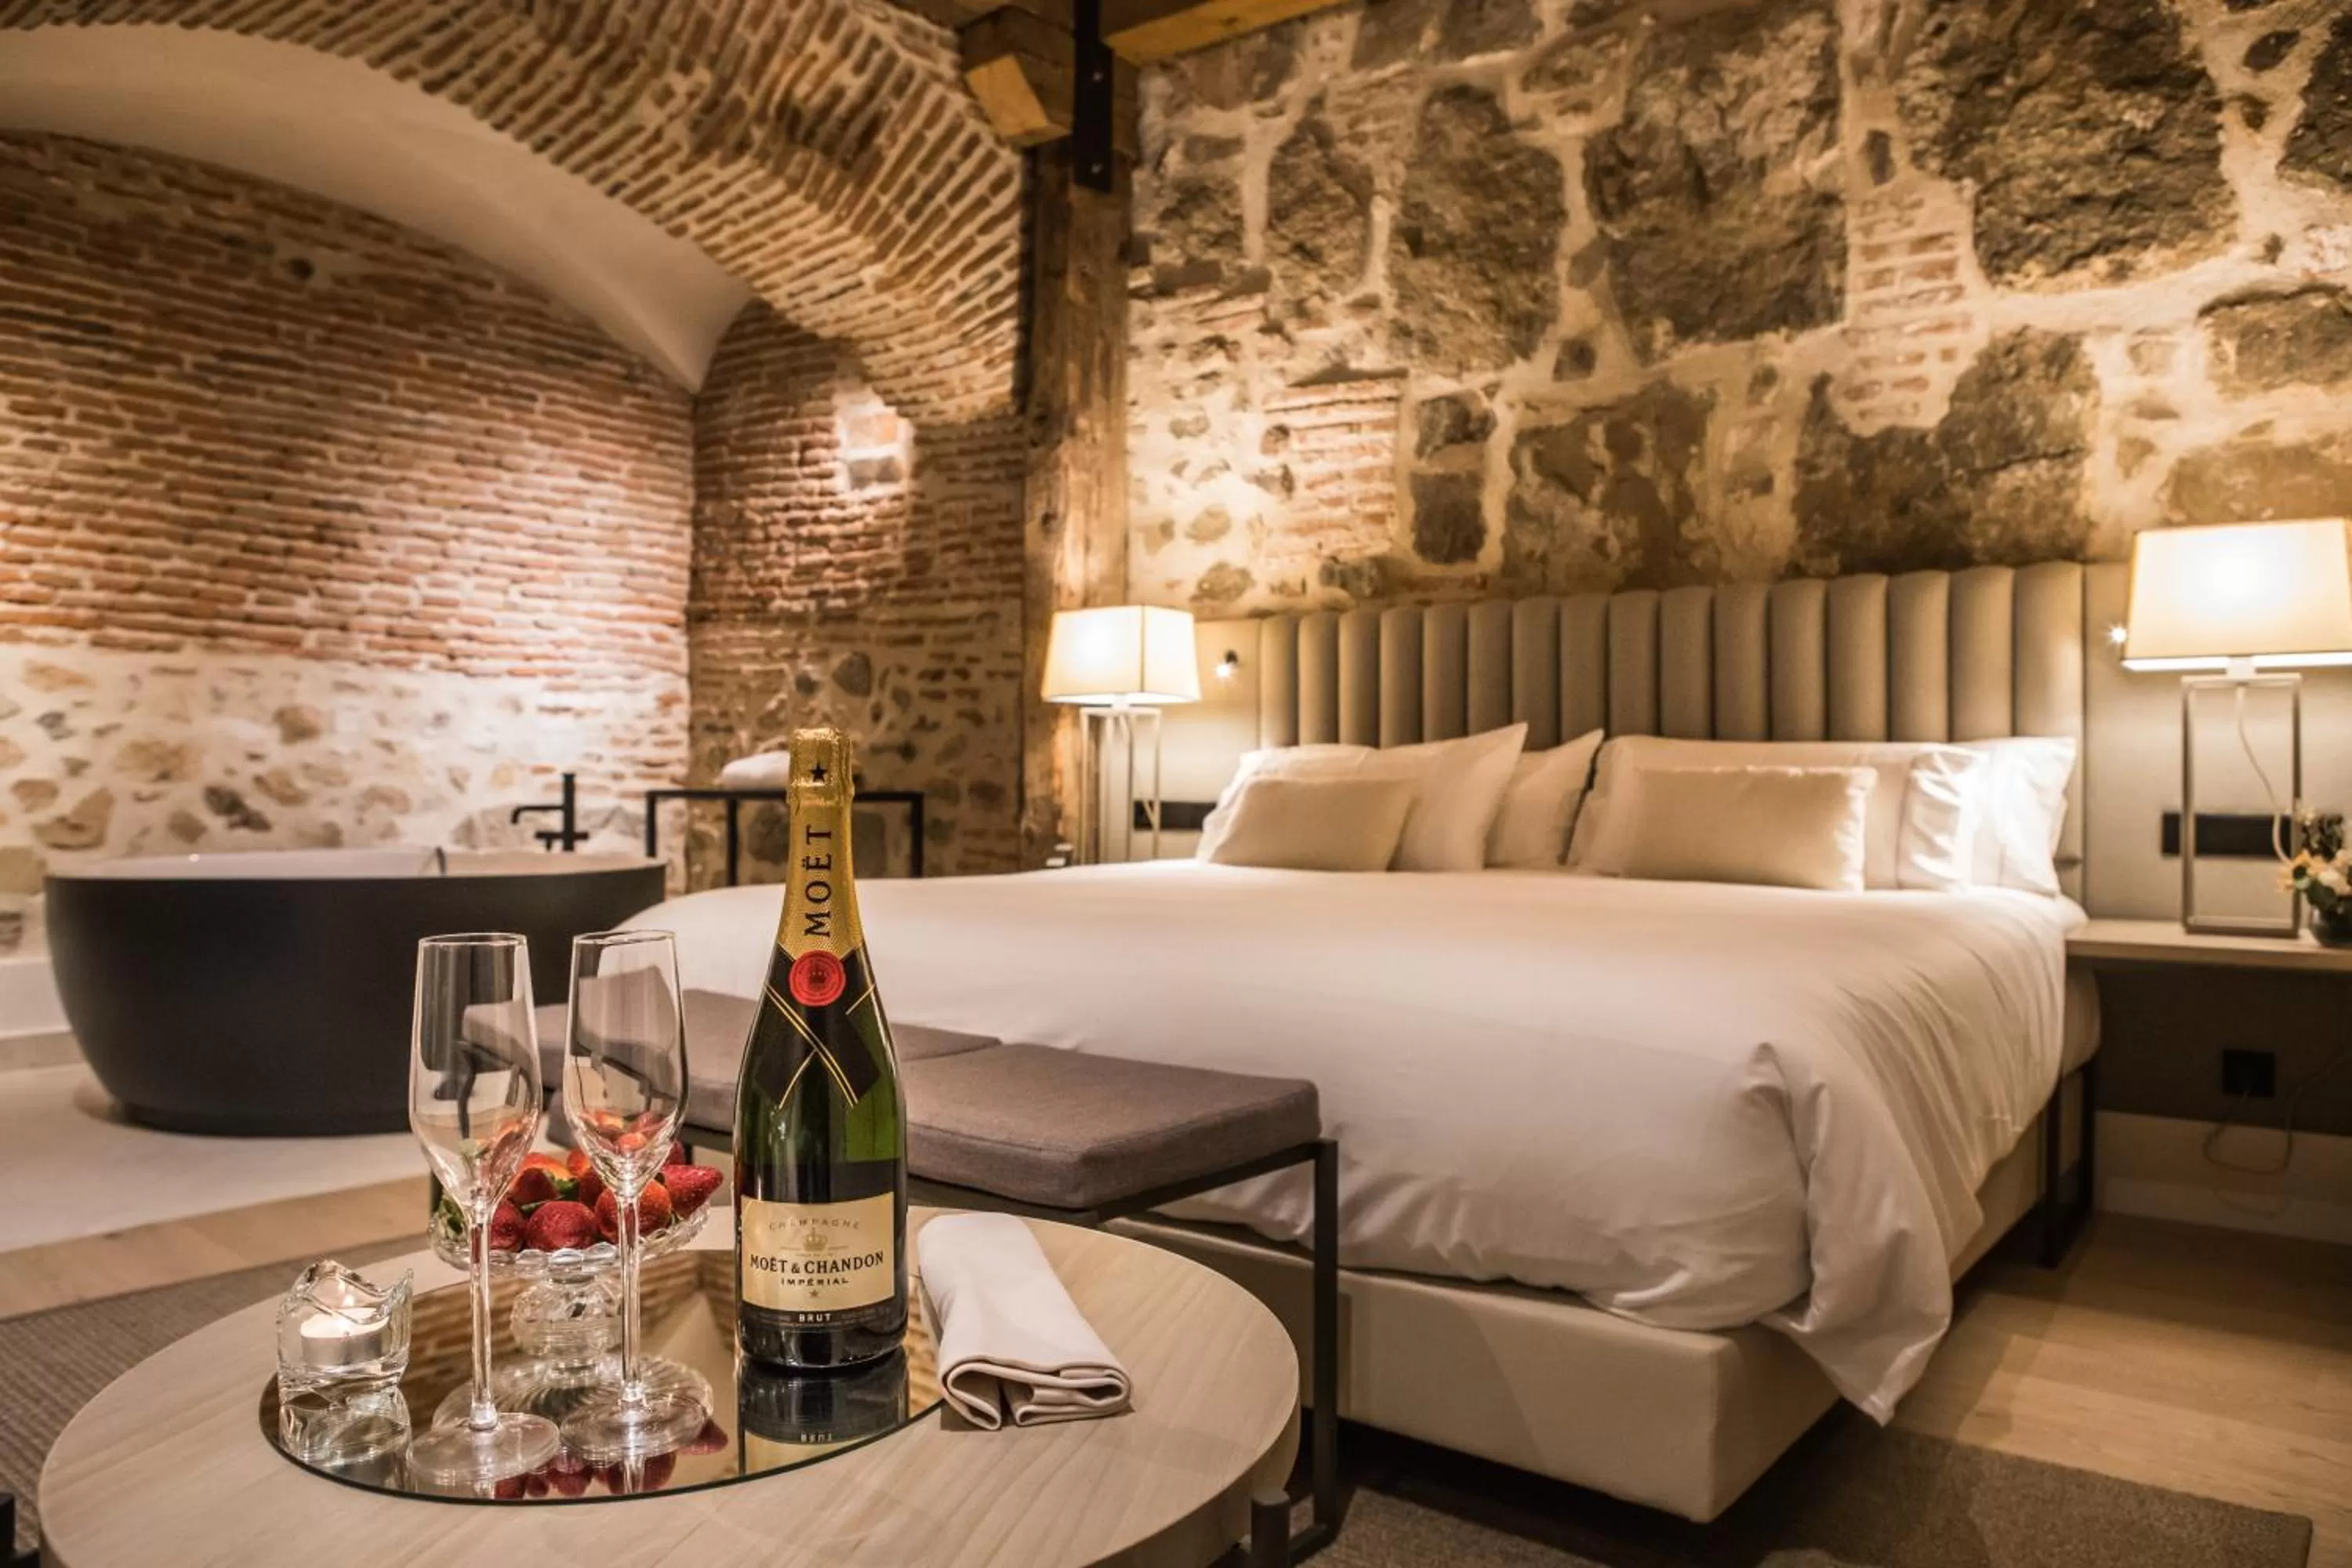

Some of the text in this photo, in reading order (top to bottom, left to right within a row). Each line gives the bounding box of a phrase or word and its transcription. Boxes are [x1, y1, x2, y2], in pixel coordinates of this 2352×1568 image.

[801, 824, 832, 938] MOËT
[791, 1263, 800, 1274] &
[804, 1250, 884, 1274] CHANDON
[799, 1313, 832, 1323] BRUT
